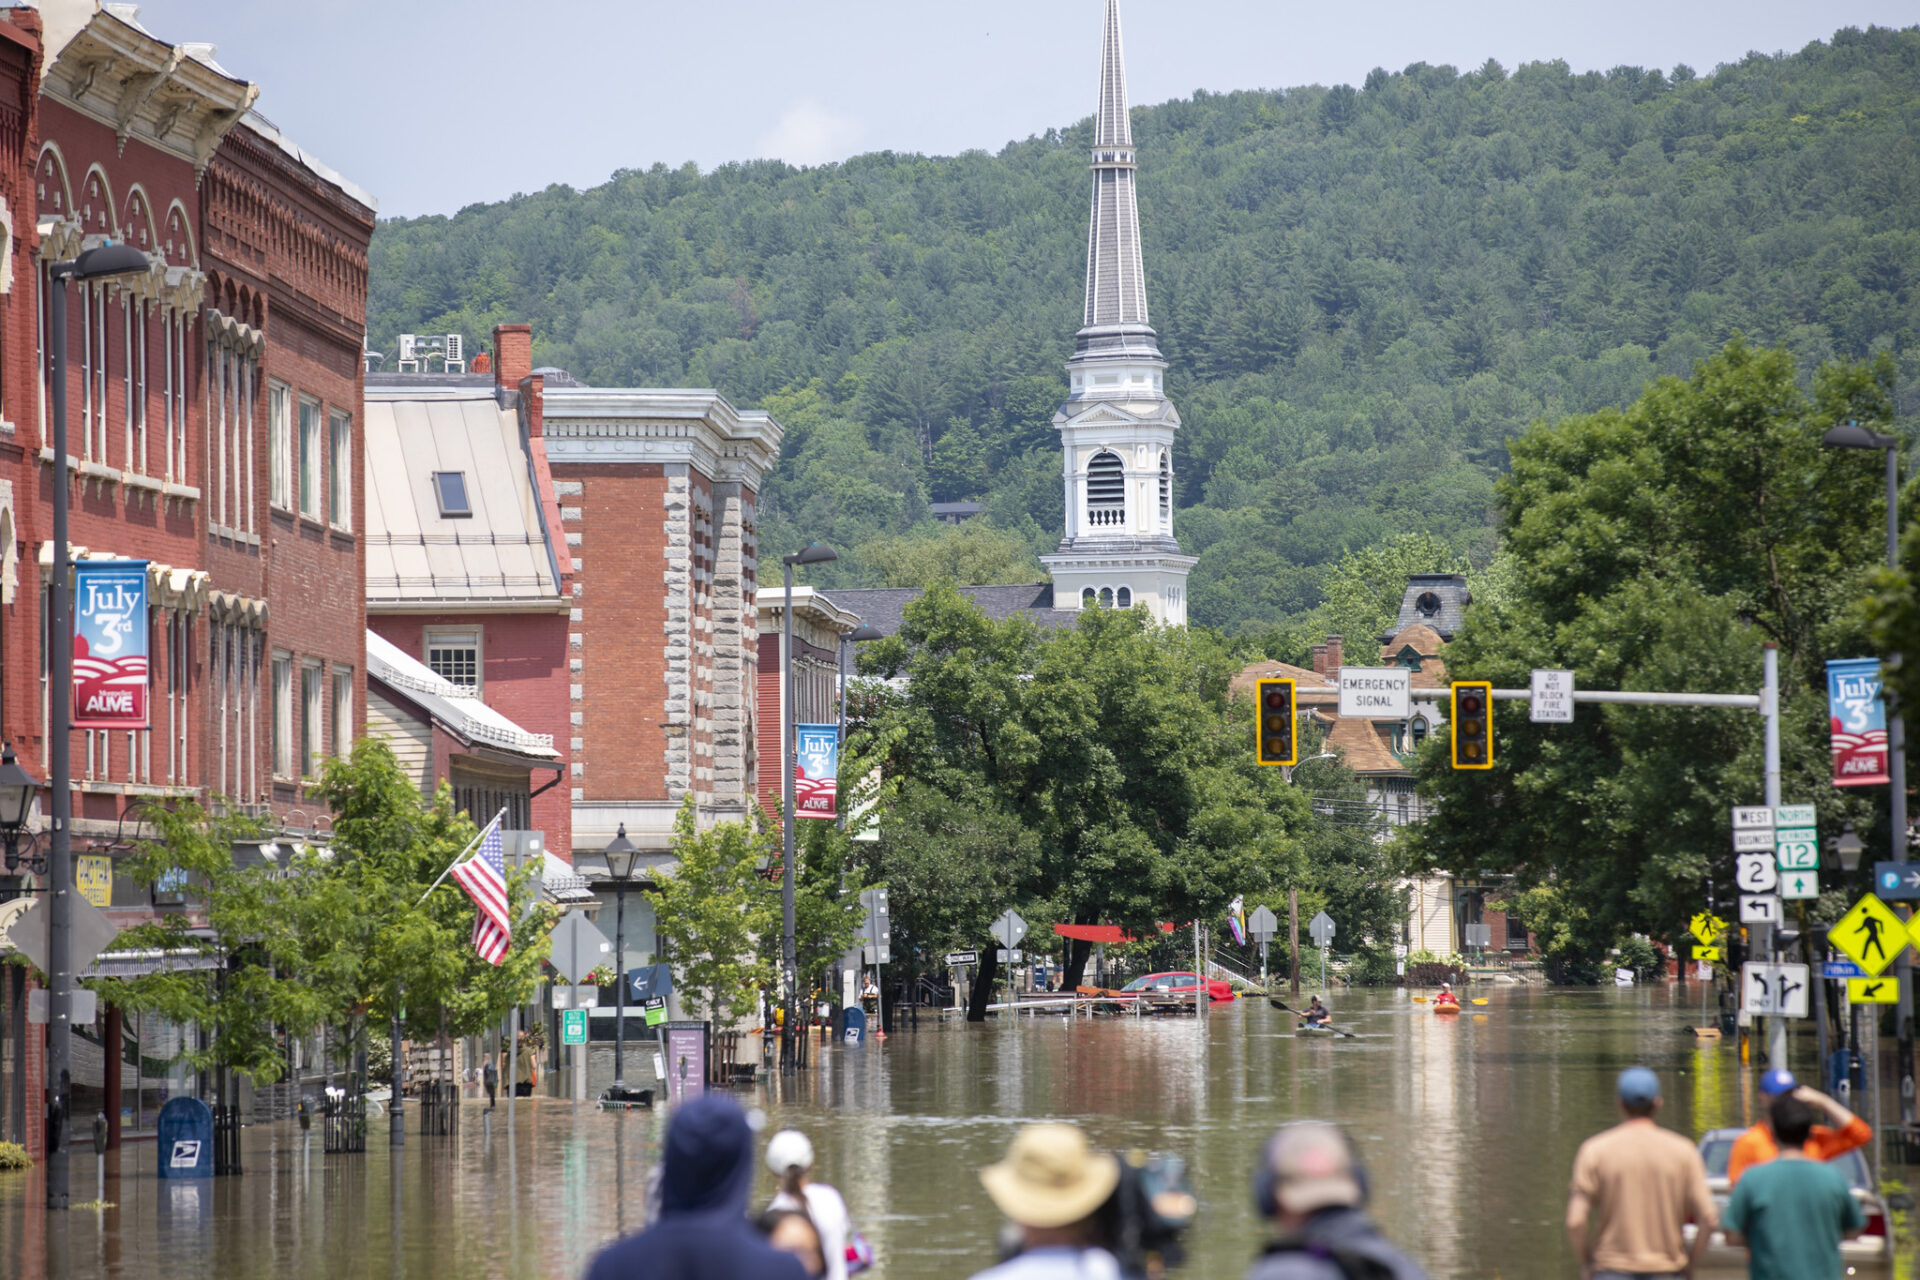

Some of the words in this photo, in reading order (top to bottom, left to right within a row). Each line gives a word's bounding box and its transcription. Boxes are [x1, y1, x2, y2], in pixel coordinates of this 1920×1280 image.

[81, 584, 141, 619] July
[94, 613, 133, 655] 3rd
[1548, 673, 1558, 681] DO
[1343, 678, 1405, 690] EMERGENCY
[1545, 682, 1560, 690] NOT
[1835, 677, 1879, 703] July
[1356, 695, 1392, 707] SIGNAL
[1540, 691, 1563, 699] BLOCK
[85, 695, 133, 713] ALIVE
[1544, 701, 1560, 709] FIRE
[1537, 710, 1567, 718] STATION
[1844, 699, 1875, 730] 3rd
[801, 737, 834, 758] July
[807, 753, 829, 776] 3rd
[1842, 759, 1879, 773] ALIVE
[803, 799, 829, 809] ALIVE
[1741, 811, 1767, 823] WEST
[1778, 810, 1813, 821] NORTH
[1737, 835, 1771, 845] BUSINESS
[1779, 831, 1813, 840] VERMONT
[1785, 844, 1810, 865] 12
[1750, 861, 1764, 883] 2
[1750, 999, 1769, 1007] ONLY
